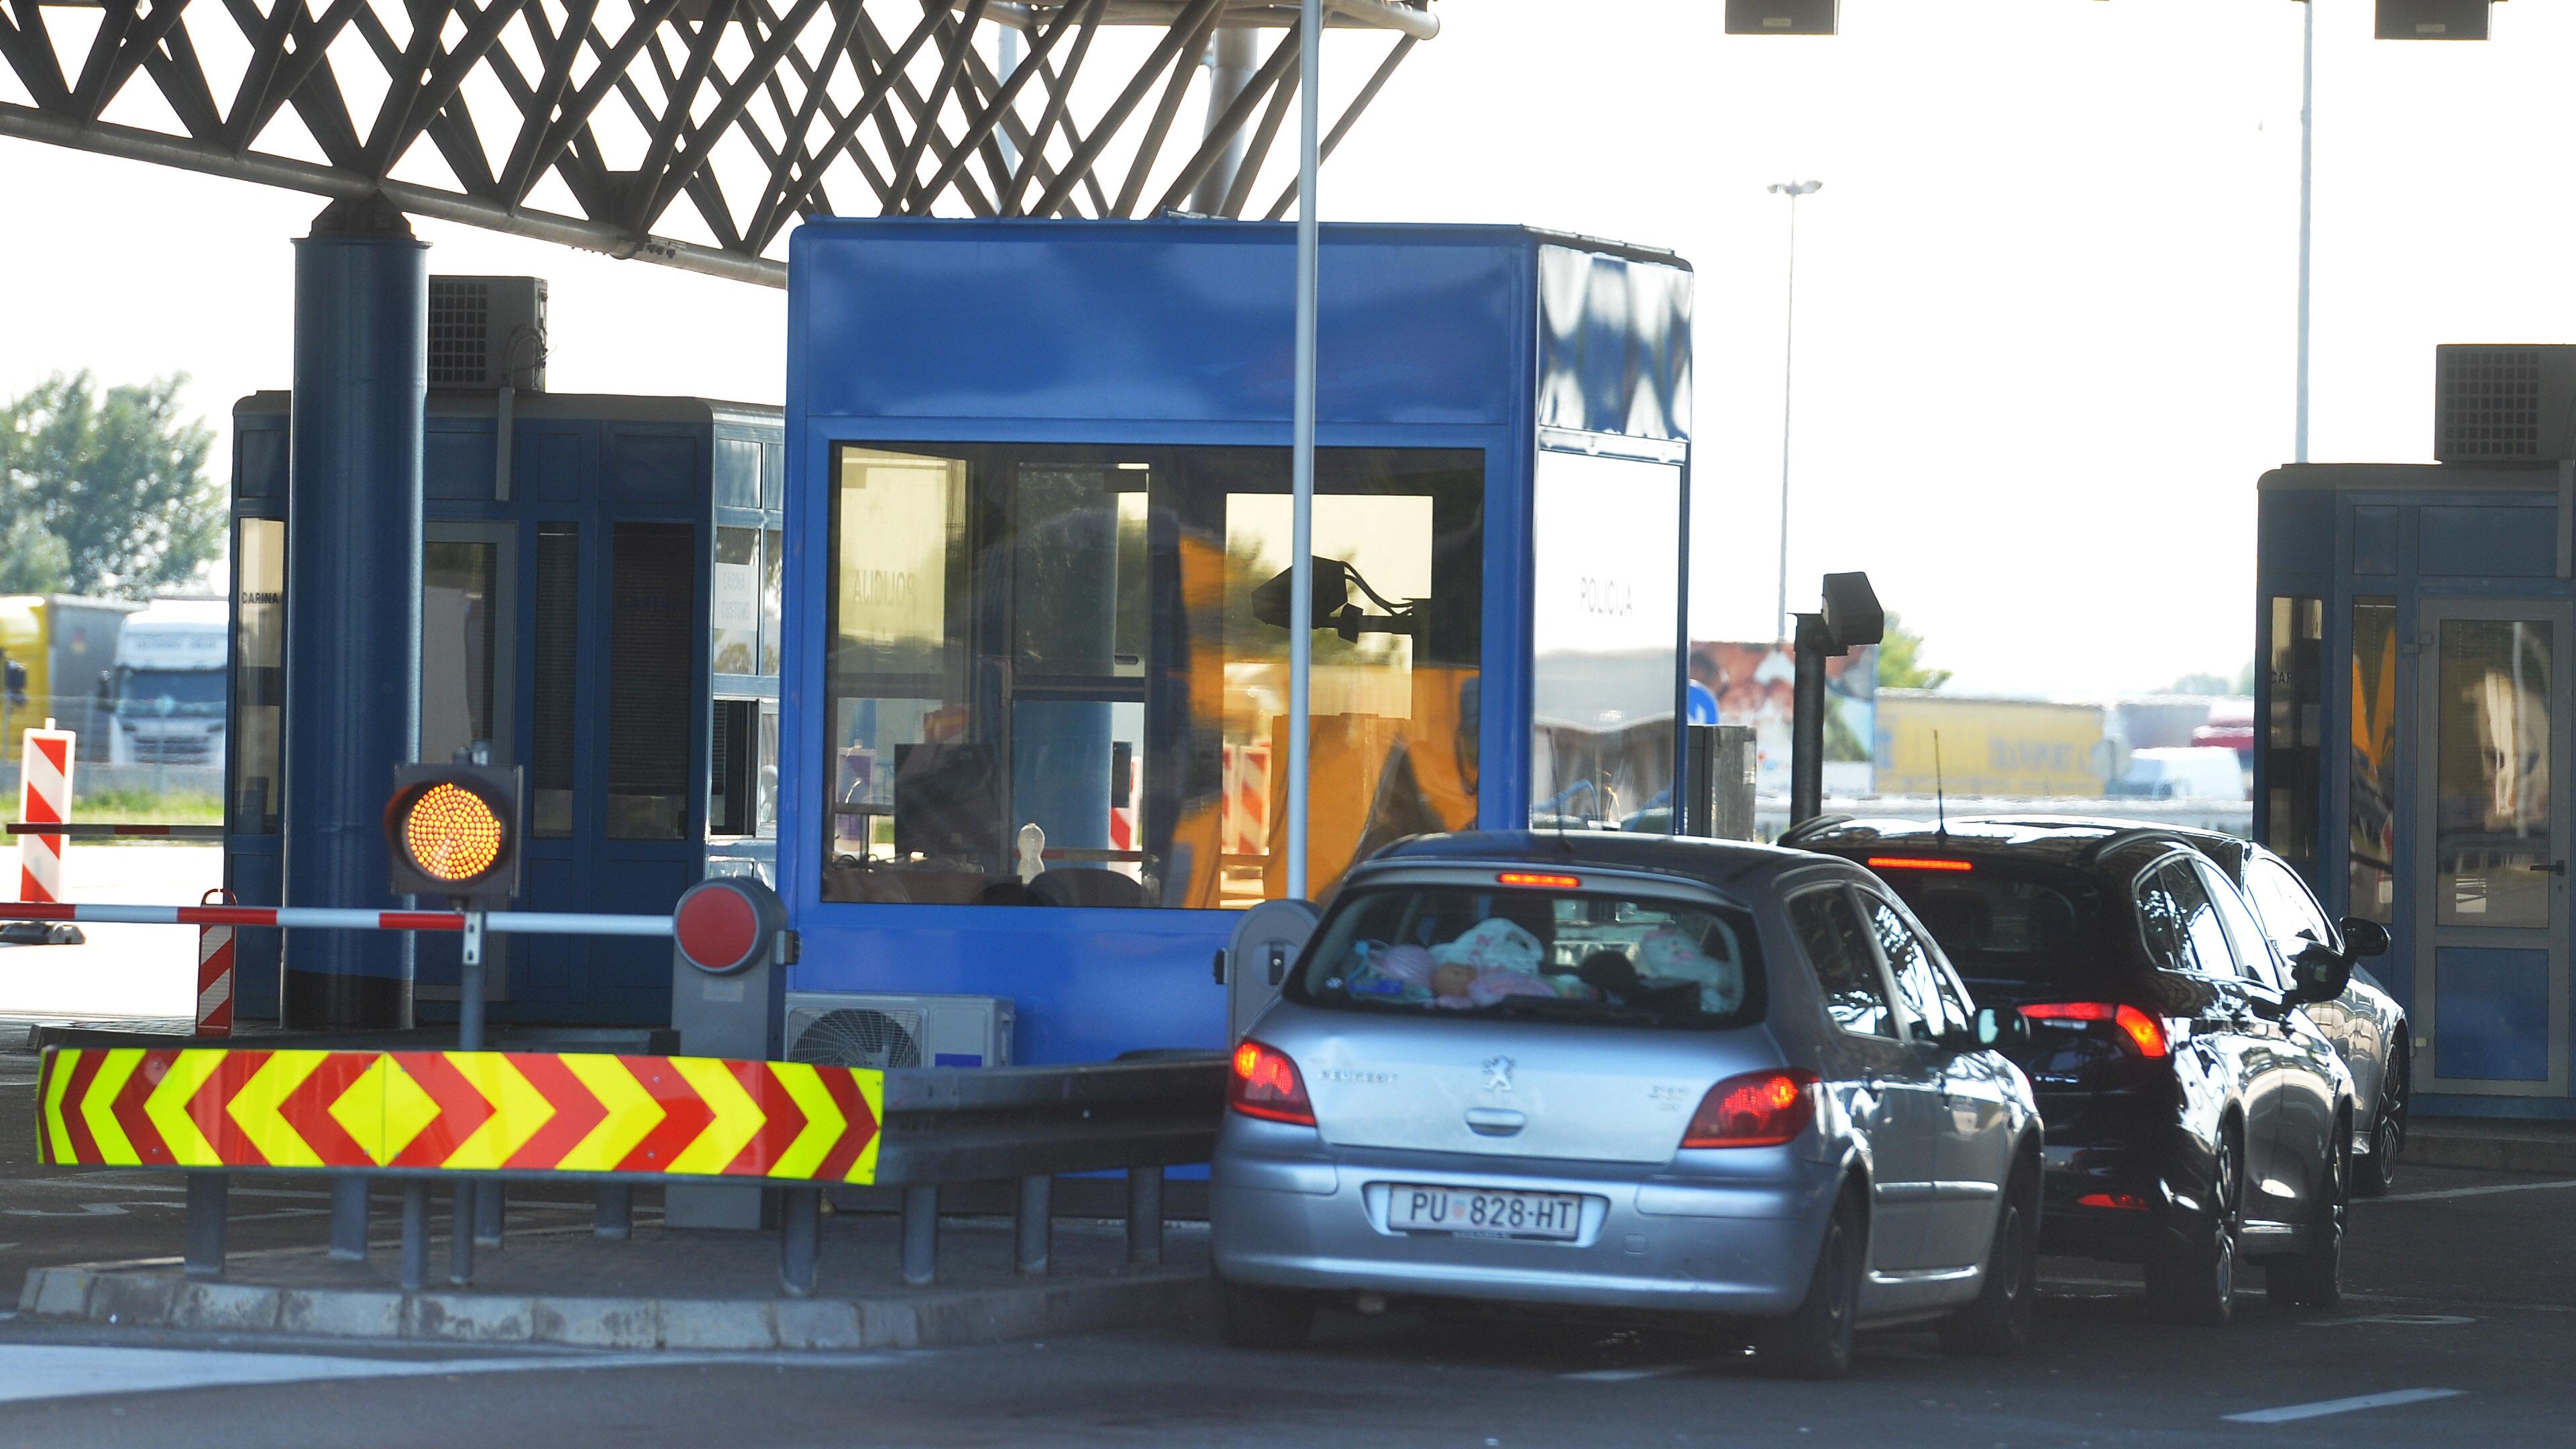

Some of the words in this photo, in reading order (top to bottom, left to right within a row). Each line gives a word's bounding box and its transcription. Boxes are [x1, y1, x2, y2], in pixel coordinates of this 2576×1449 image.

[241, 592, 279, 604] CARINA
[1580, 576, 1633, 618] POLICIJA
[1410, 1191, 1448, 1223] PU
[1470, 1195, 1573, 1229] 828-HT
